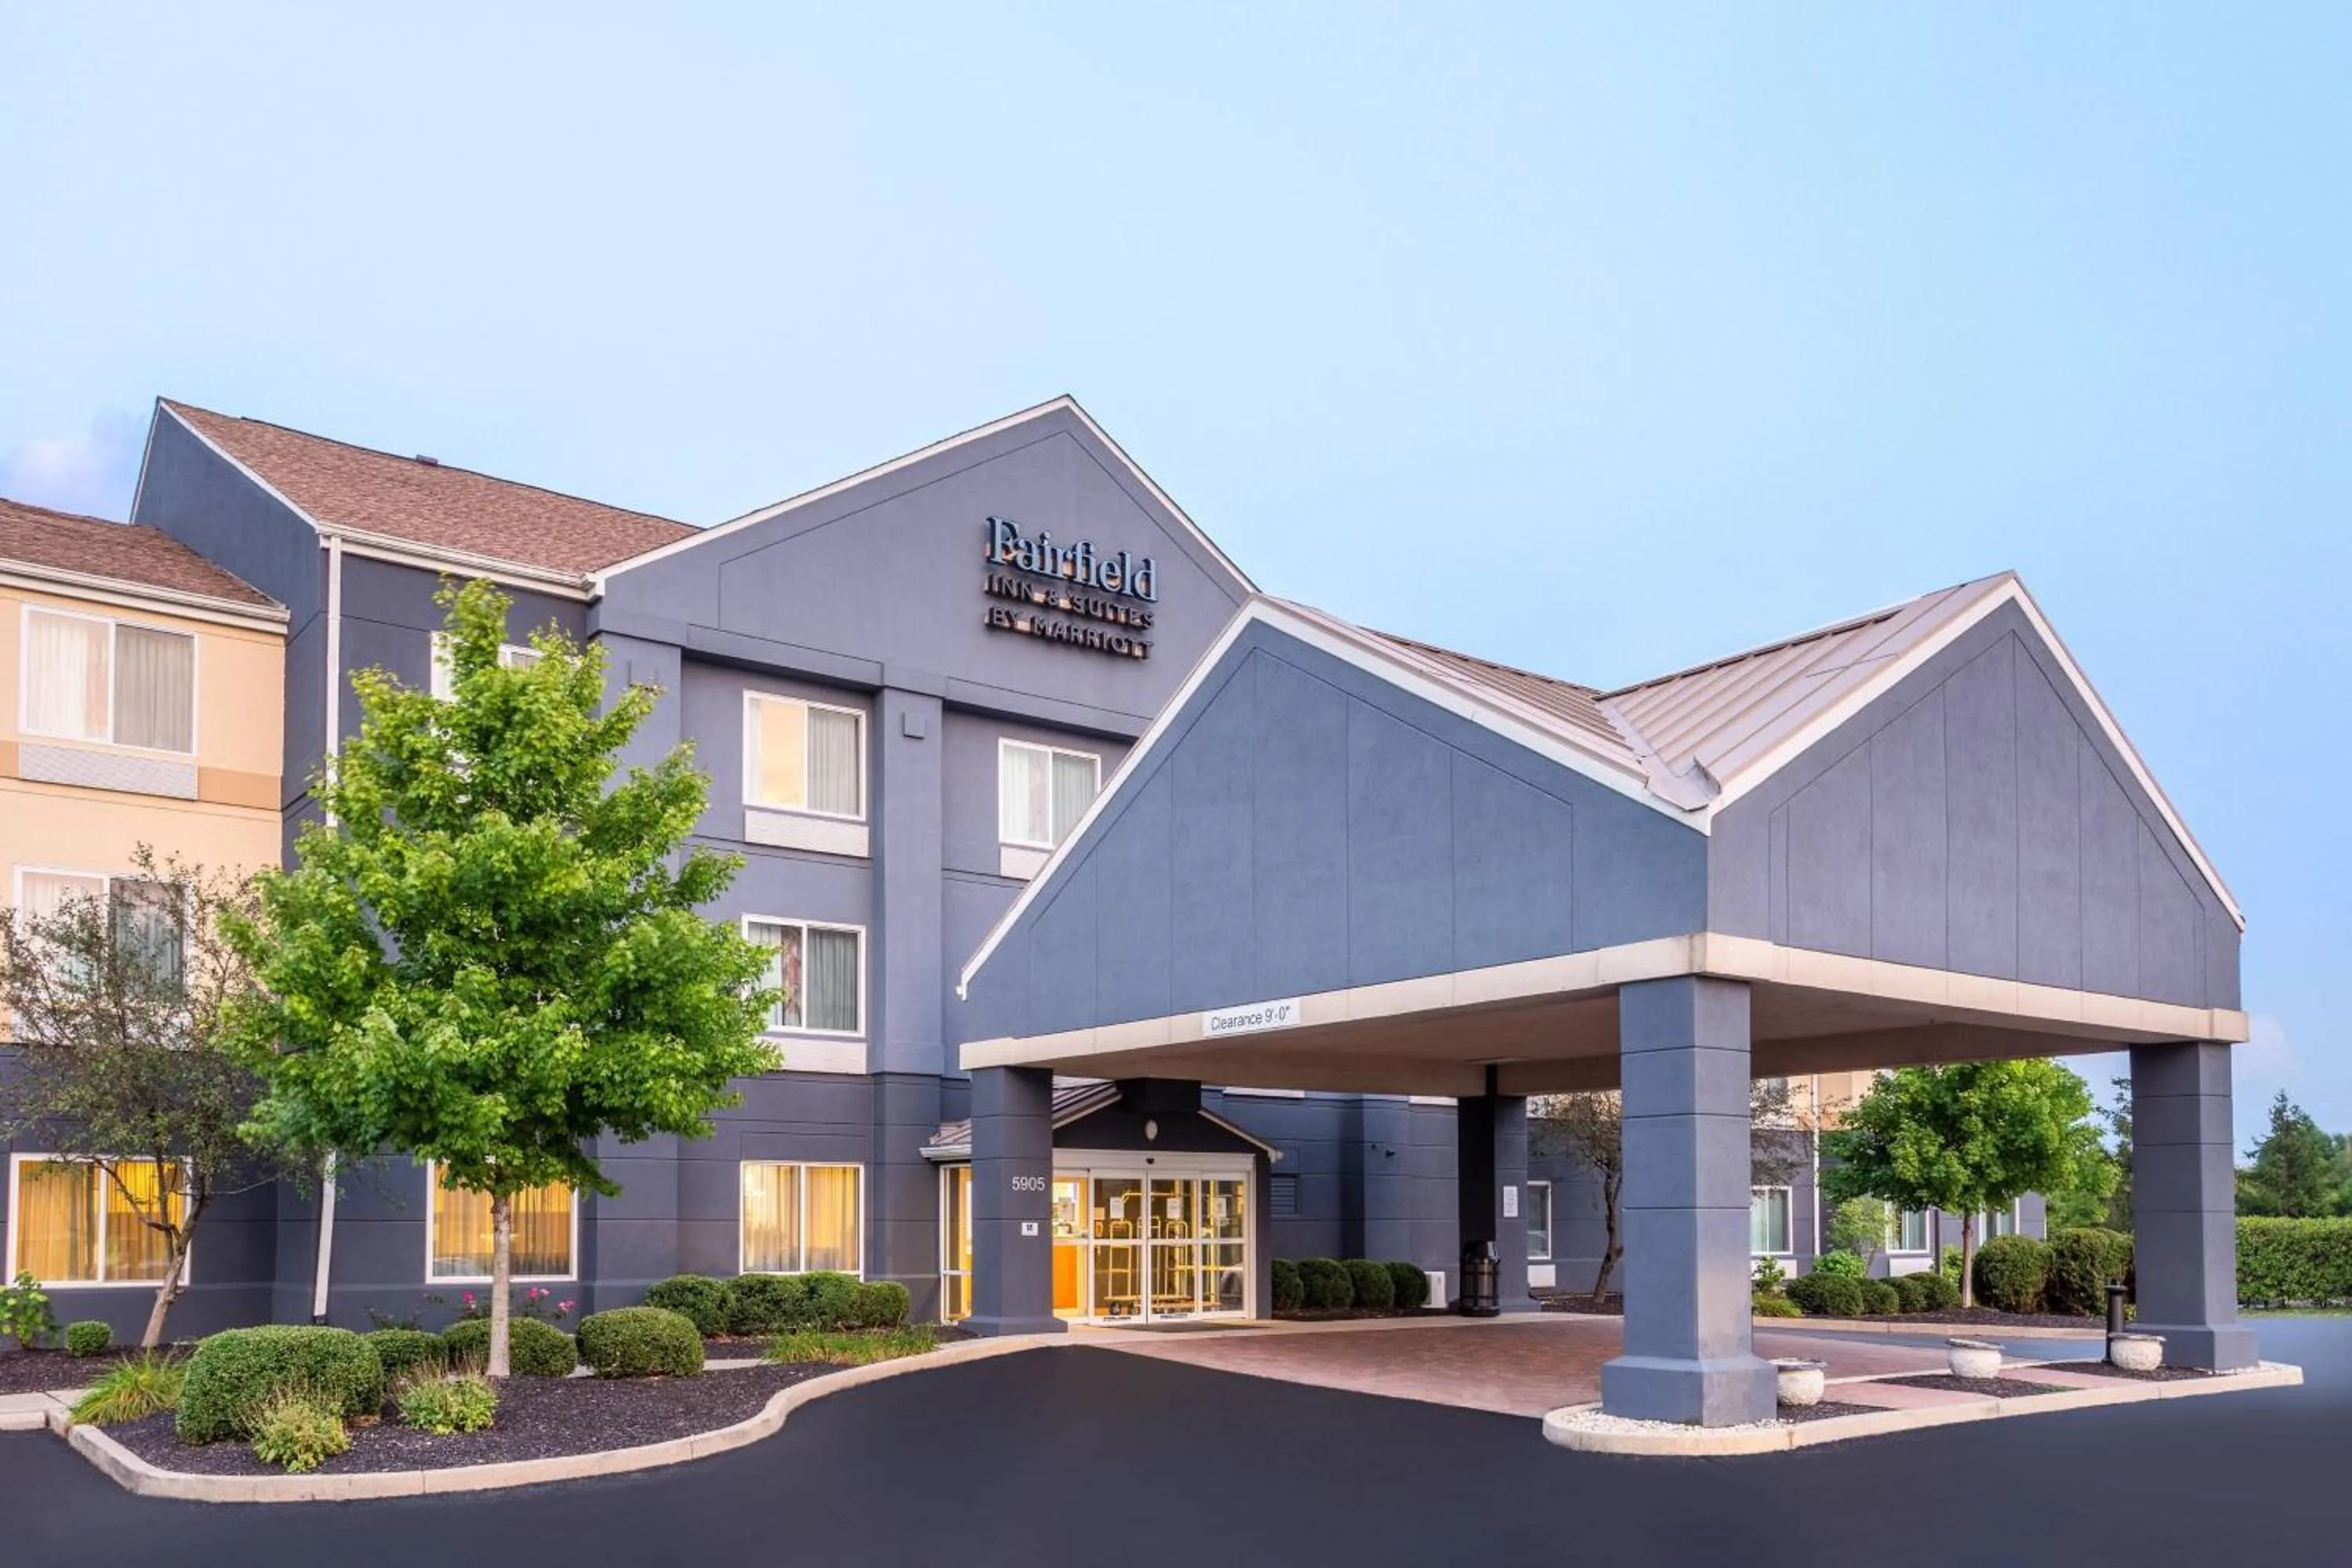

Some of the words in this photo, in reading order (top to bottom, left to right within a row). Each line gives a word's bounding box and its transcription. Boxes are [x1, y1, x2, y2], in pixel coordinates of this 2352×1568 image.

[986, 516, 1157, 602] Fairfield
[987, 573, 1034, 600] INN
[1048, 589, 1059, 607] &
[1073, 597, 1155, 630] SUITES
[989, 607, 1019, 627] BY
[1033, 615, 1154, 659] MARRIOTT
[1211, 1014, 1262, 1030] Clearance
[1012, 1176, 1046, 1191] 5905
